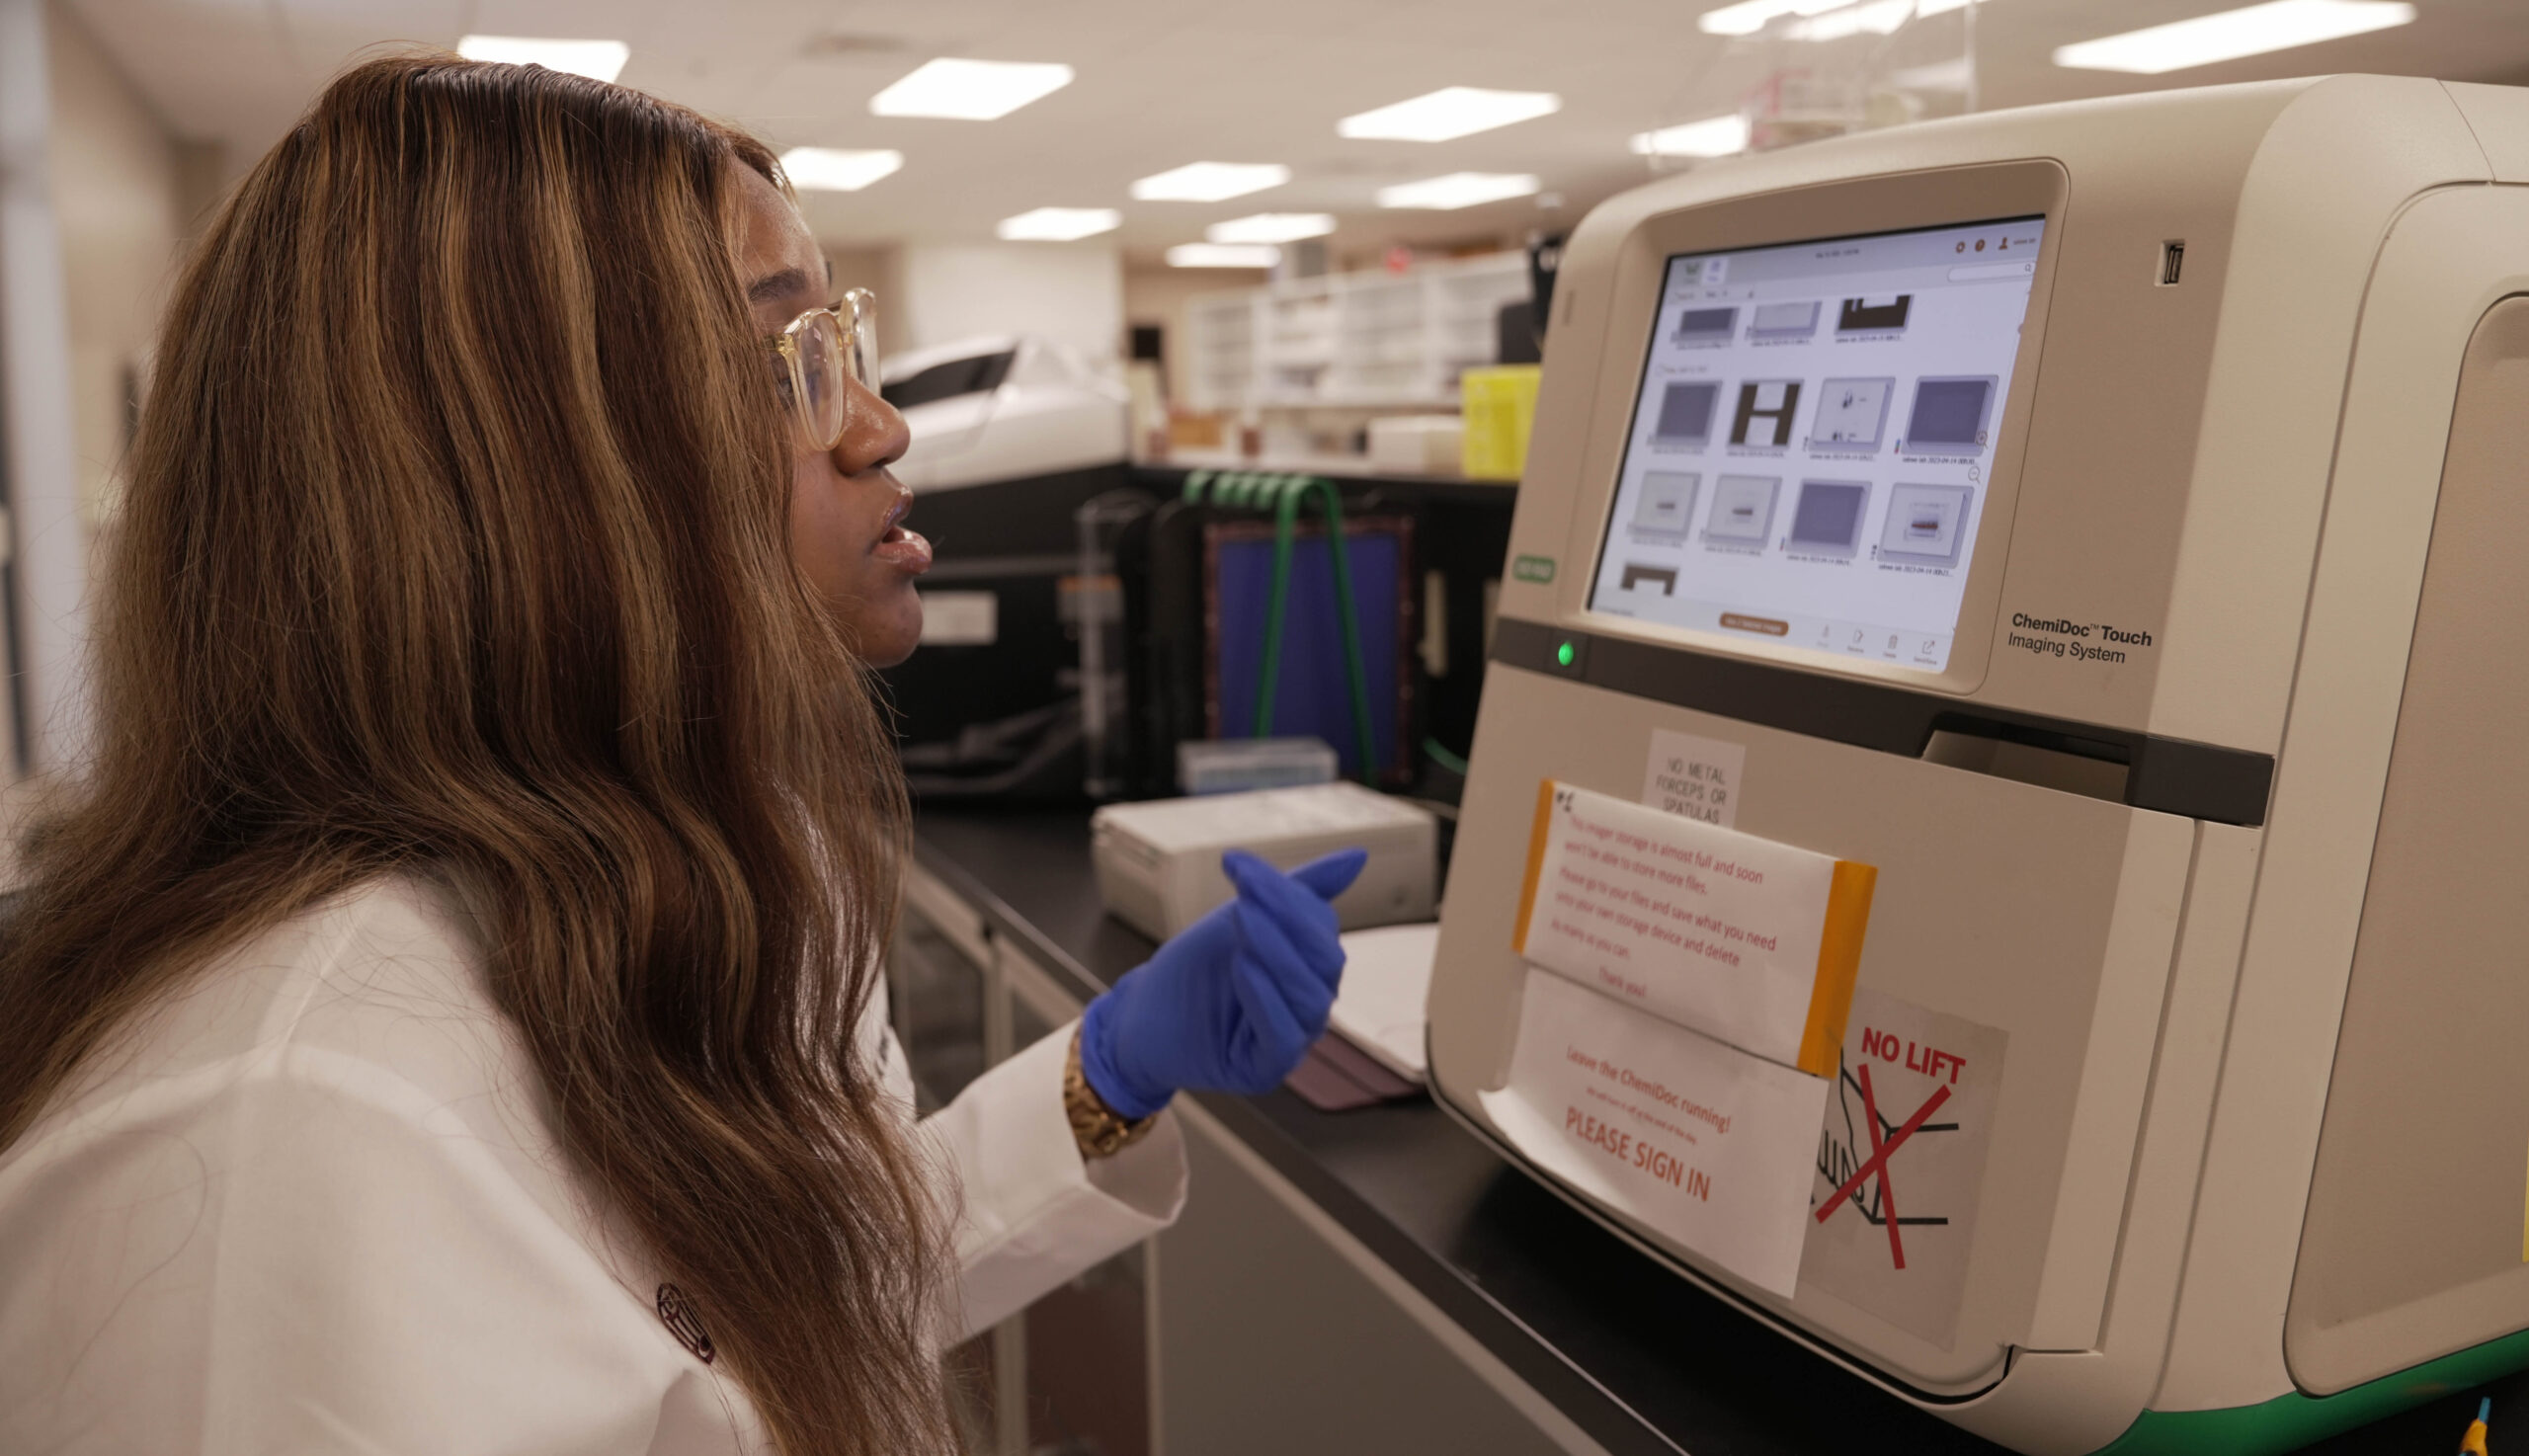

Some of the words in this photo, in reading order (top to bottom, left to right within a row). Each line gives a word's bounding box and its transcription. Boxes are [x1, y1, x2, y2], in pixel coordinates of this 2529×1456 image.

[2008, 631, 2065, 657] Imaging
[2070, 641, 2126, 664] System
[2101, 625, 2153, 647] Touch
[1656, 774, 1704, 800] FORCEPS
[1710, 788, 1727, 805] OR
[1667, 757, 1682, 774] NO
[1688, 763, 1726, 785] METAL
[1664, 796, 1720, 824] SPATULAS
[1601, 851, 1619, 866] able
[1620, 856, 1630, 869] to
[1632, 861, 1656, 879] store
[1658, 869, 1683, 887] more
[1685, 875, 1707, 894] files.
[1615, 832, 1649, 851] storage
[1650, 841, 1658, 853] is
[1660, 845, 1693, 863] almost
[1694, 850, 1713, 869] full
[1713, 860, 1735, 876] and
[1736, 866, 1763, 884] soon
[1596, 906, 1614, 920] own
[1615, 913, 1649, 935] storage
[1650, 925, 1681, 946] device
[1683, 938, 1704, 955] and
[1704, 943, 1741, 968] delete
[1608, 887, 1629, 901] your
[1630, 890, 1650, 908] files
[1651, 900, 1671, 916] and
[1672, 907, 1692, 923] save
[1694, 915, 1723, 933] what
[1724, 925, 1745, 941] you
[1746, 932, 1777, 951] need
[1595, 938, 1611, 952] you
[1599, 965, 1624, 990] Thank
[1861, 1026, 1901, 1063] NO
[1906, 1040, 1967, 1086] LIFT
[1567, 1045, 1597, 1070] Leave
[1599, 1060, 1618, 1081] the
[1620, 1068, 1679, 1108] ChemiDoc
[1680, 1098, 1732, 1135] running!
[1566, 1106, 1631, 1161] PLEASE
[1633, 1141, 1683, 1188] SIGN
[1685, 1168, 1711, 1202] IN
